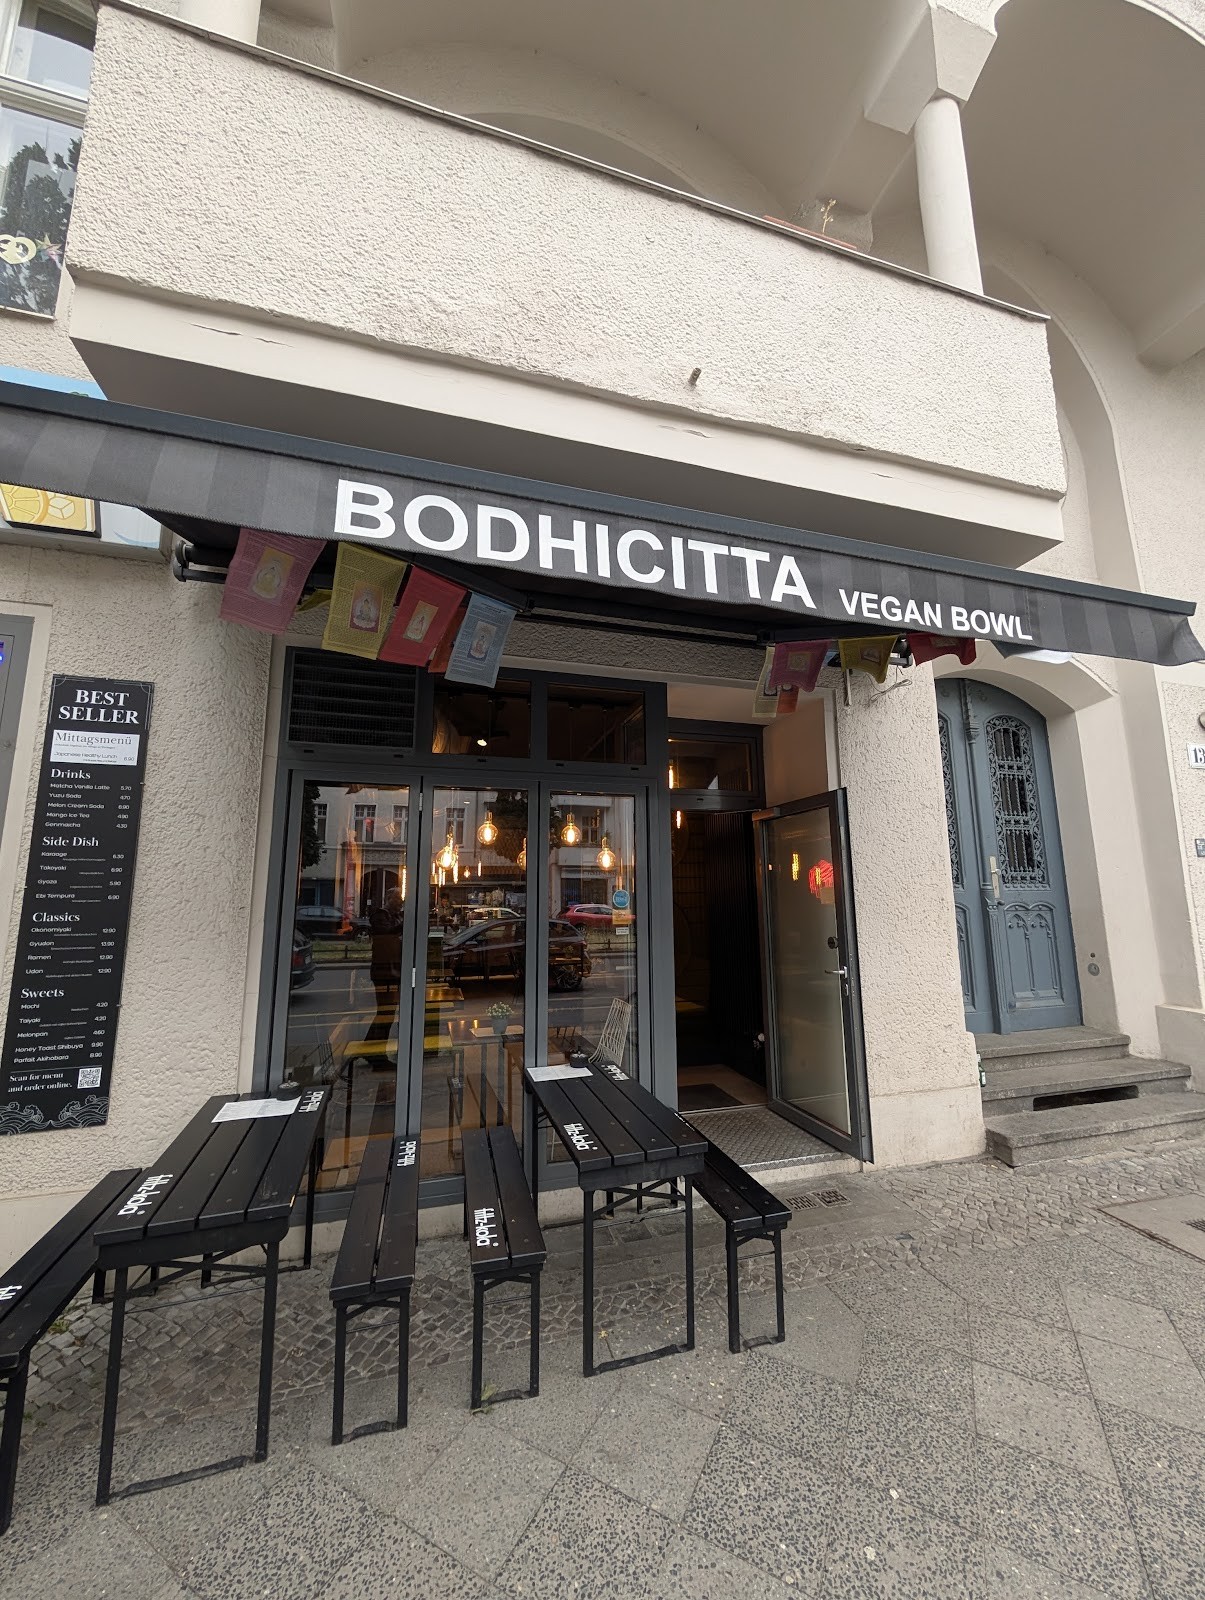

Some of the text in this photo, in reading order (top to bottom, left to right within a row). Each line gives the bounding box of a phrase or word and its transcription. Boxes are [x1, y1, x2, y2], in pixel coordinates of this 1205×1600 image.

[334, 479, 1033, 641] BODHICITTA VEGAN BOWL
[75, 689, 129, 707] BEST
[58, 705, 140, 725] SELLER
[55, 732, 132, 746] Mittagsmenü
[51, 768, 91, 780] Drinks
[42, 836, 99, 847] Side Dish
[32, 911, 81, 923] Classics
[29, 940, 55, 948] Gyudon
[20, 987, 65, 999] Sweets
[19, 1017, 41, 1025] Taiyaki
[17, 1031, 49, 1039] Melonpan
[57, 1043, 84, 1051] Shibuya
[13, 1056, 36, 1064] Parfait
[36, 1054, 70, 1062] Akihabara
[8, 1085, 23, 1093] and
[24, 1083, 46, 1091] order
[117, 1174, 173, 1216] fritz-kola
[473, 1207, 499, 1247] fritz-kola
